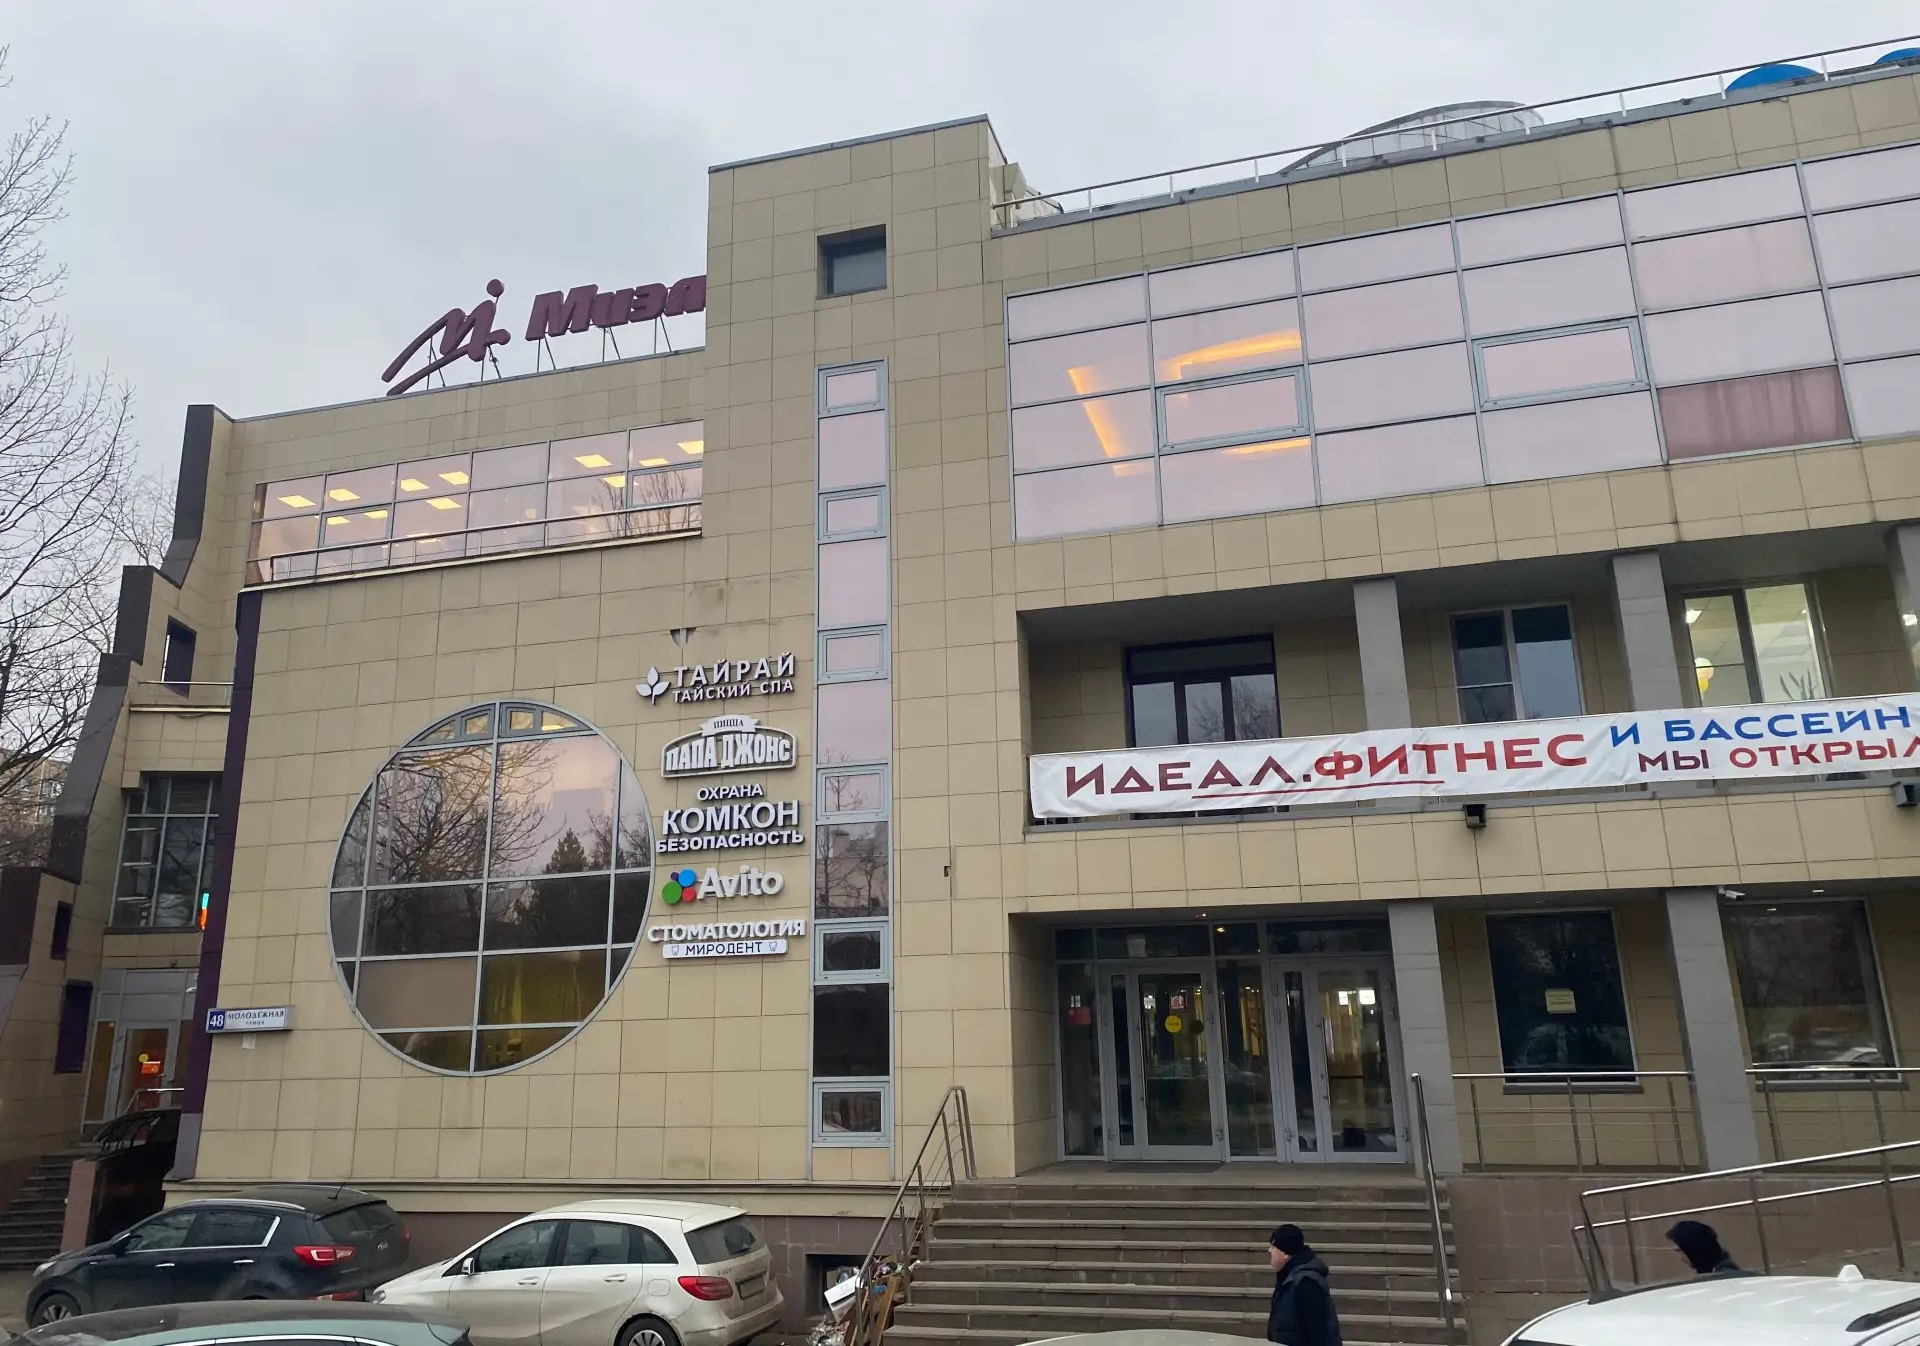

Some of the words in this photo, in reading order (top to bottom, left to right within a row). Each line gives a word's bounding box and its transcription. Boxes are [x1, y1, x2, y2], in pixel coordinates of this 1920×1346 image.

[673, 652, 795, 687] ТАЙРАЙ
[673, 683, 750, 703] ТАЙСКИЙ
[760, 679, 794, 694] СПА
[713, 718, 744, 729] ПИЦЦА
[1610, 722, 1640, 748] И
[1665, 706, 1911, 742] БАССЕЙН
[665, 736, 718, 771] ПАПА
[1638, 749, 1709, 773] МЫ
[697, 783, 764, 801] ОХРАНА
[662, 800, 800, 835] КОМКОН
[655, 830, 804, 853] БЕЗОПАСНОСТЬ
[697, 864, 784, 900] Avito
[648, 919, 806, 943] СТОМАТОЛОГИЯ
[685, 941, 763, 956] МИРОДЕНТ
[209, 1014, 224, 1027] 48
